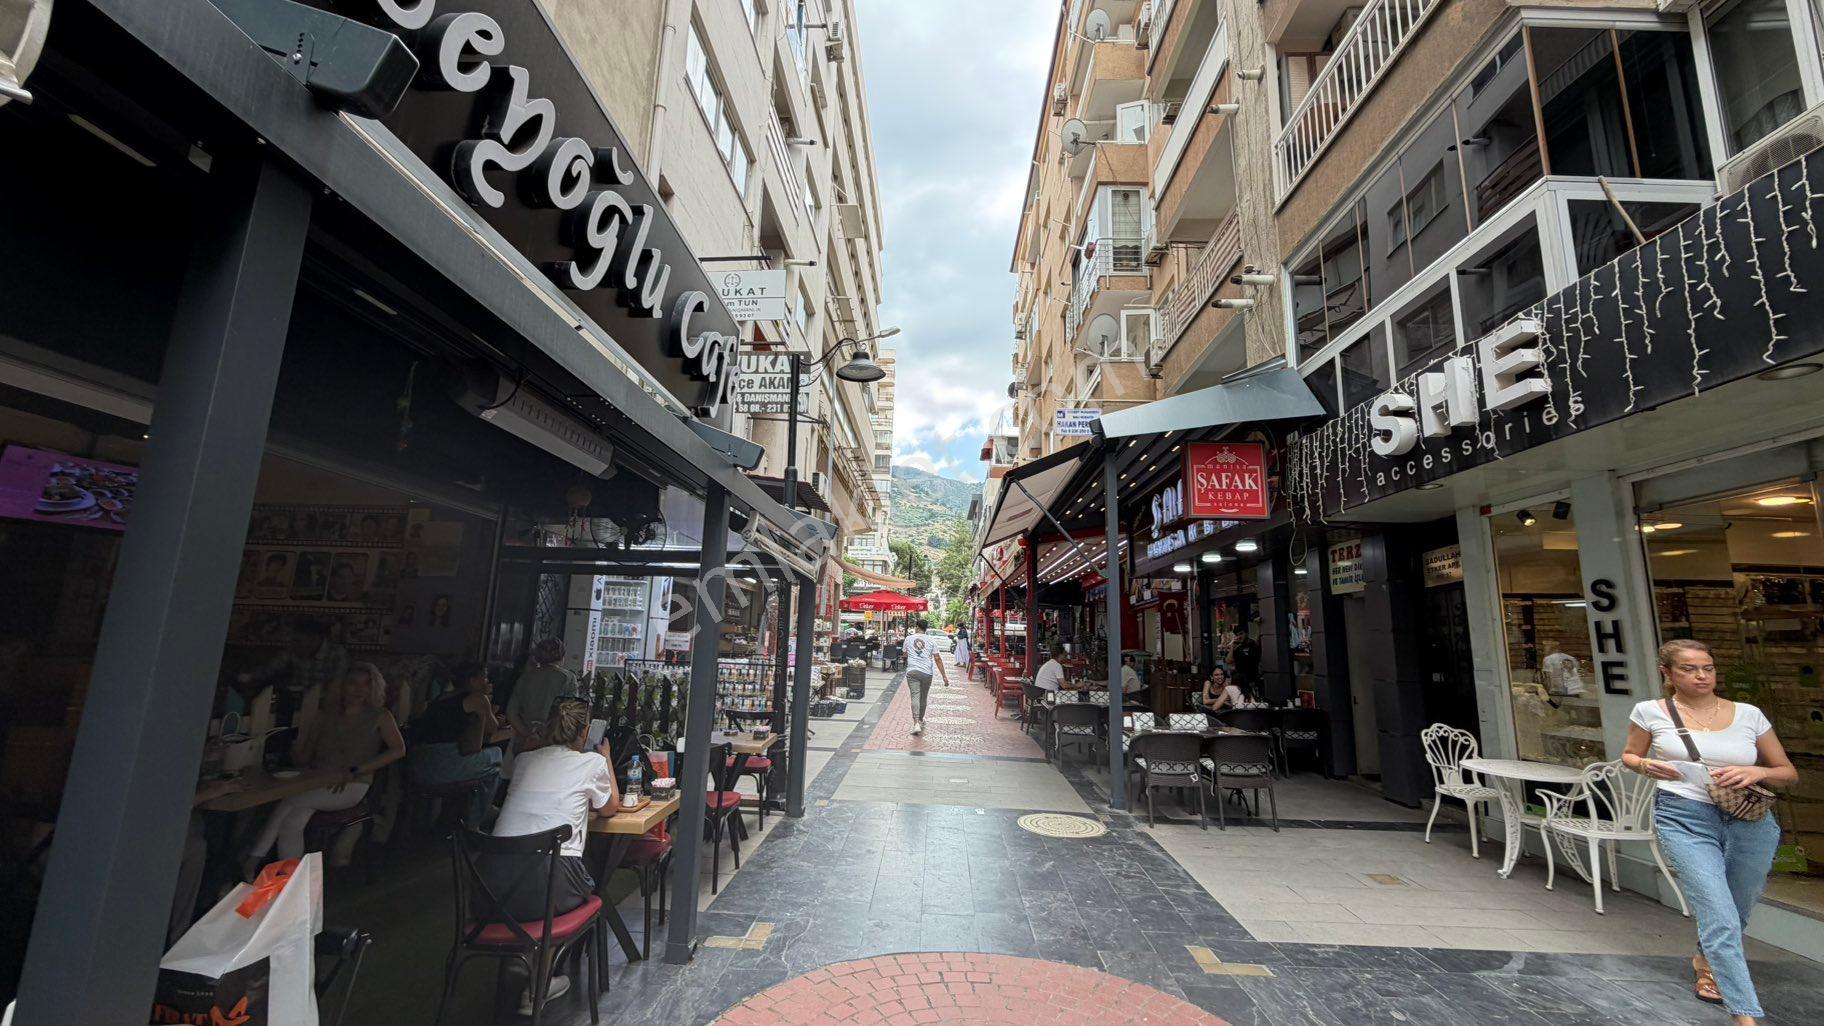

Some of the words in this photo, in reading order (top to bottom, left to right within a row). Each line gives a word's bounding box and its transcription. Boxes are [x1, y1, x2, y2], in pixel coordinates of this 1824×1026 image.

[1370, 316, 1552, 457] SHE
[1196, 472, 1259, 493] ŞAFAK
[1375, 394, 1586, 487] accessories
[1208, 492, 1249, 500] KEBAP
[1590, 578, 1630, 696] SHE
